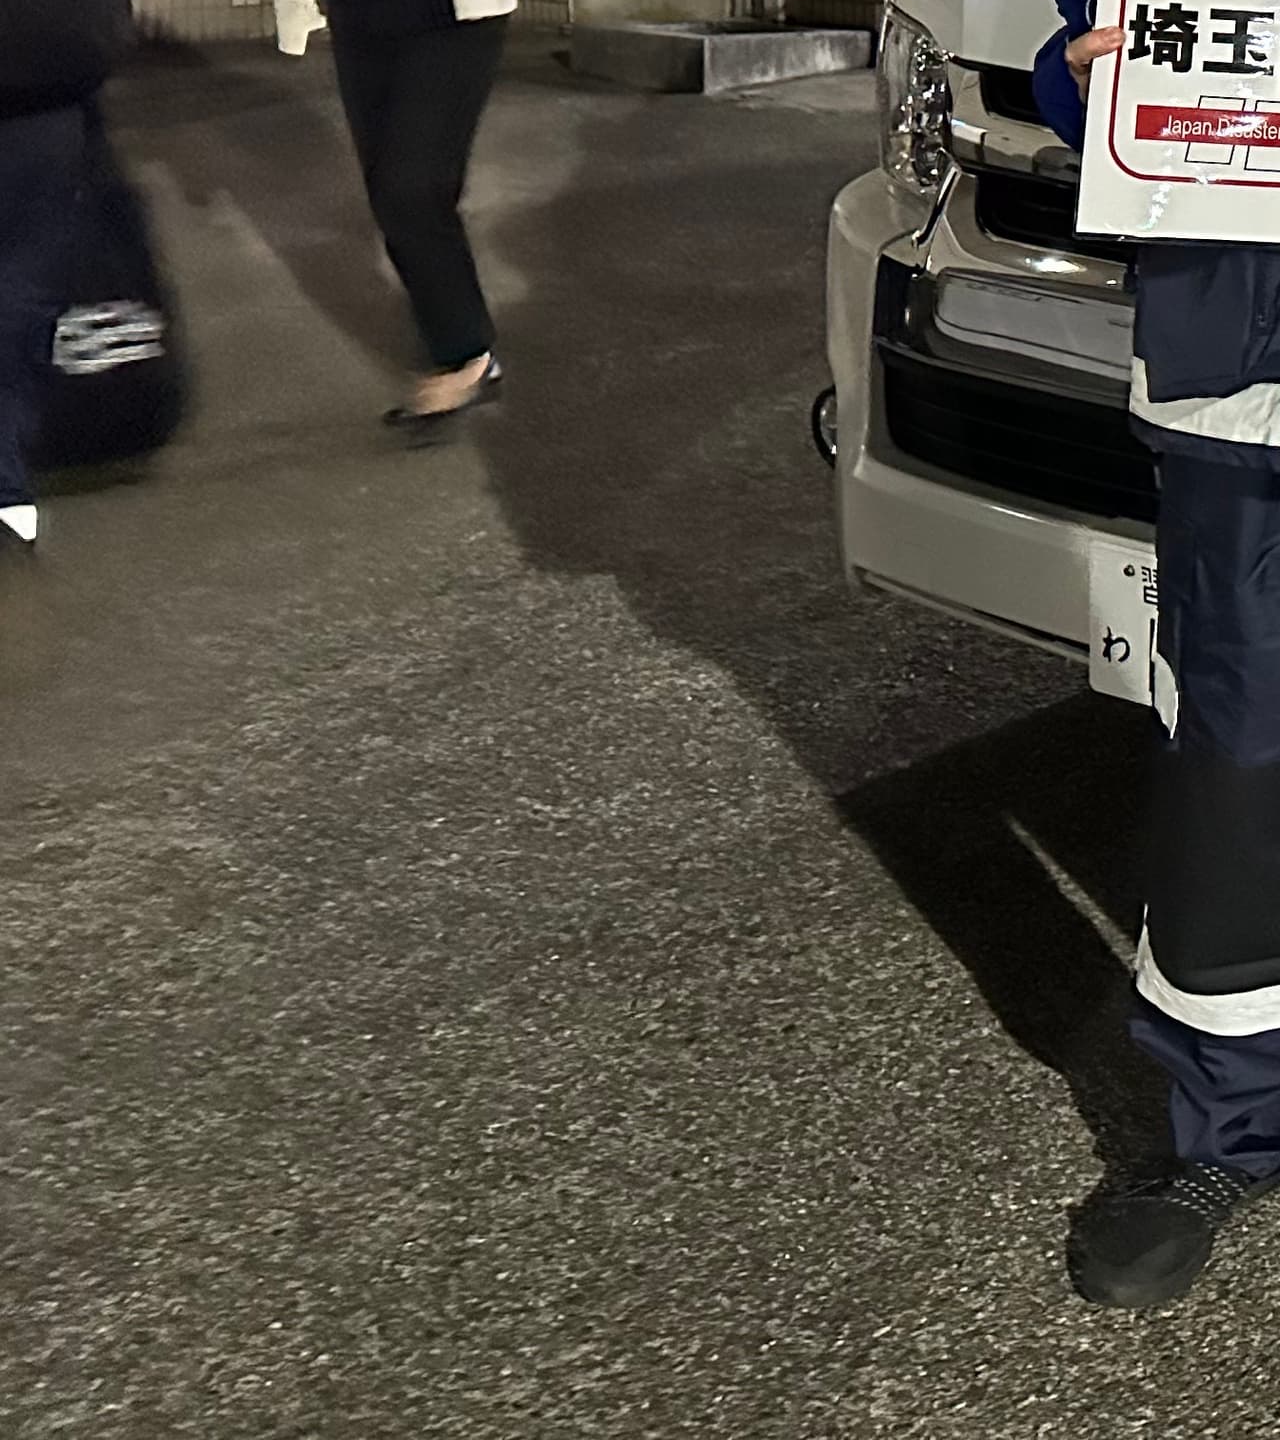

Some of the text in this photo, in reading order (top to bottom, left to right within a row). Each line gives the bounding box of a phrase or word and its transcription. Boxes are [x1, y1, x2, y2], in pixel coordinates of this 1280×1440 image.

[1128, 2, 1275, 76] 埼玉
[1164, 114, 1212, 139] Japan
[1102, 625, 1131, 663] わ
